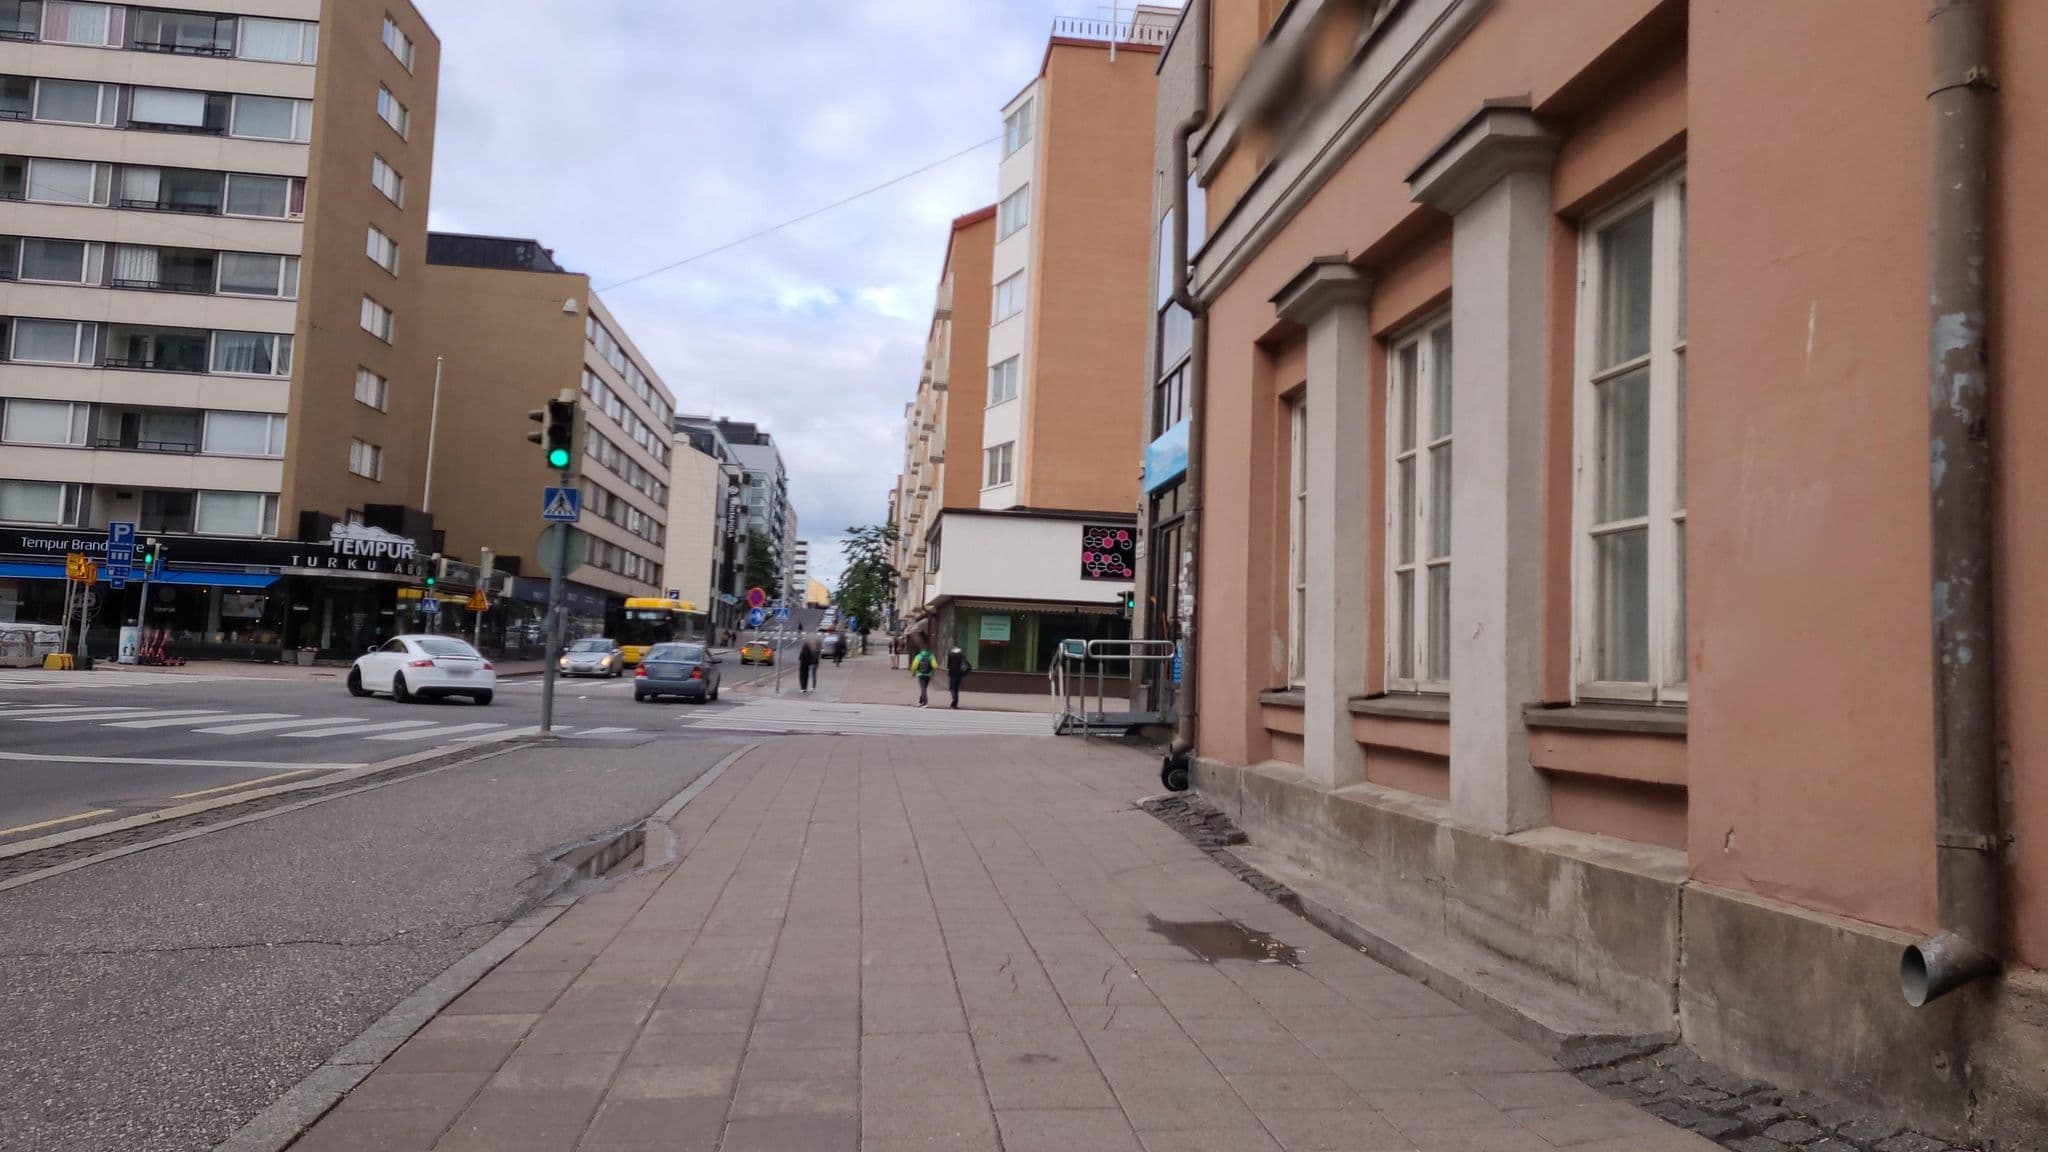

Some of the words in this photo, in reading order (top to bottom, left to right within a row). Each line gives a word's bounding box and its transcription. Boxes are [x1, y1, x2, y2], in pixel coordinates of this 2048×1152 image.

[114, 524, 131, 542] P
[21, 536, 69, 552] Tempur
[72, 539, 109, 552] Brand
[332, 538, 414, 560] TEMPUR
[291, 555, 377, 571] TURKU
